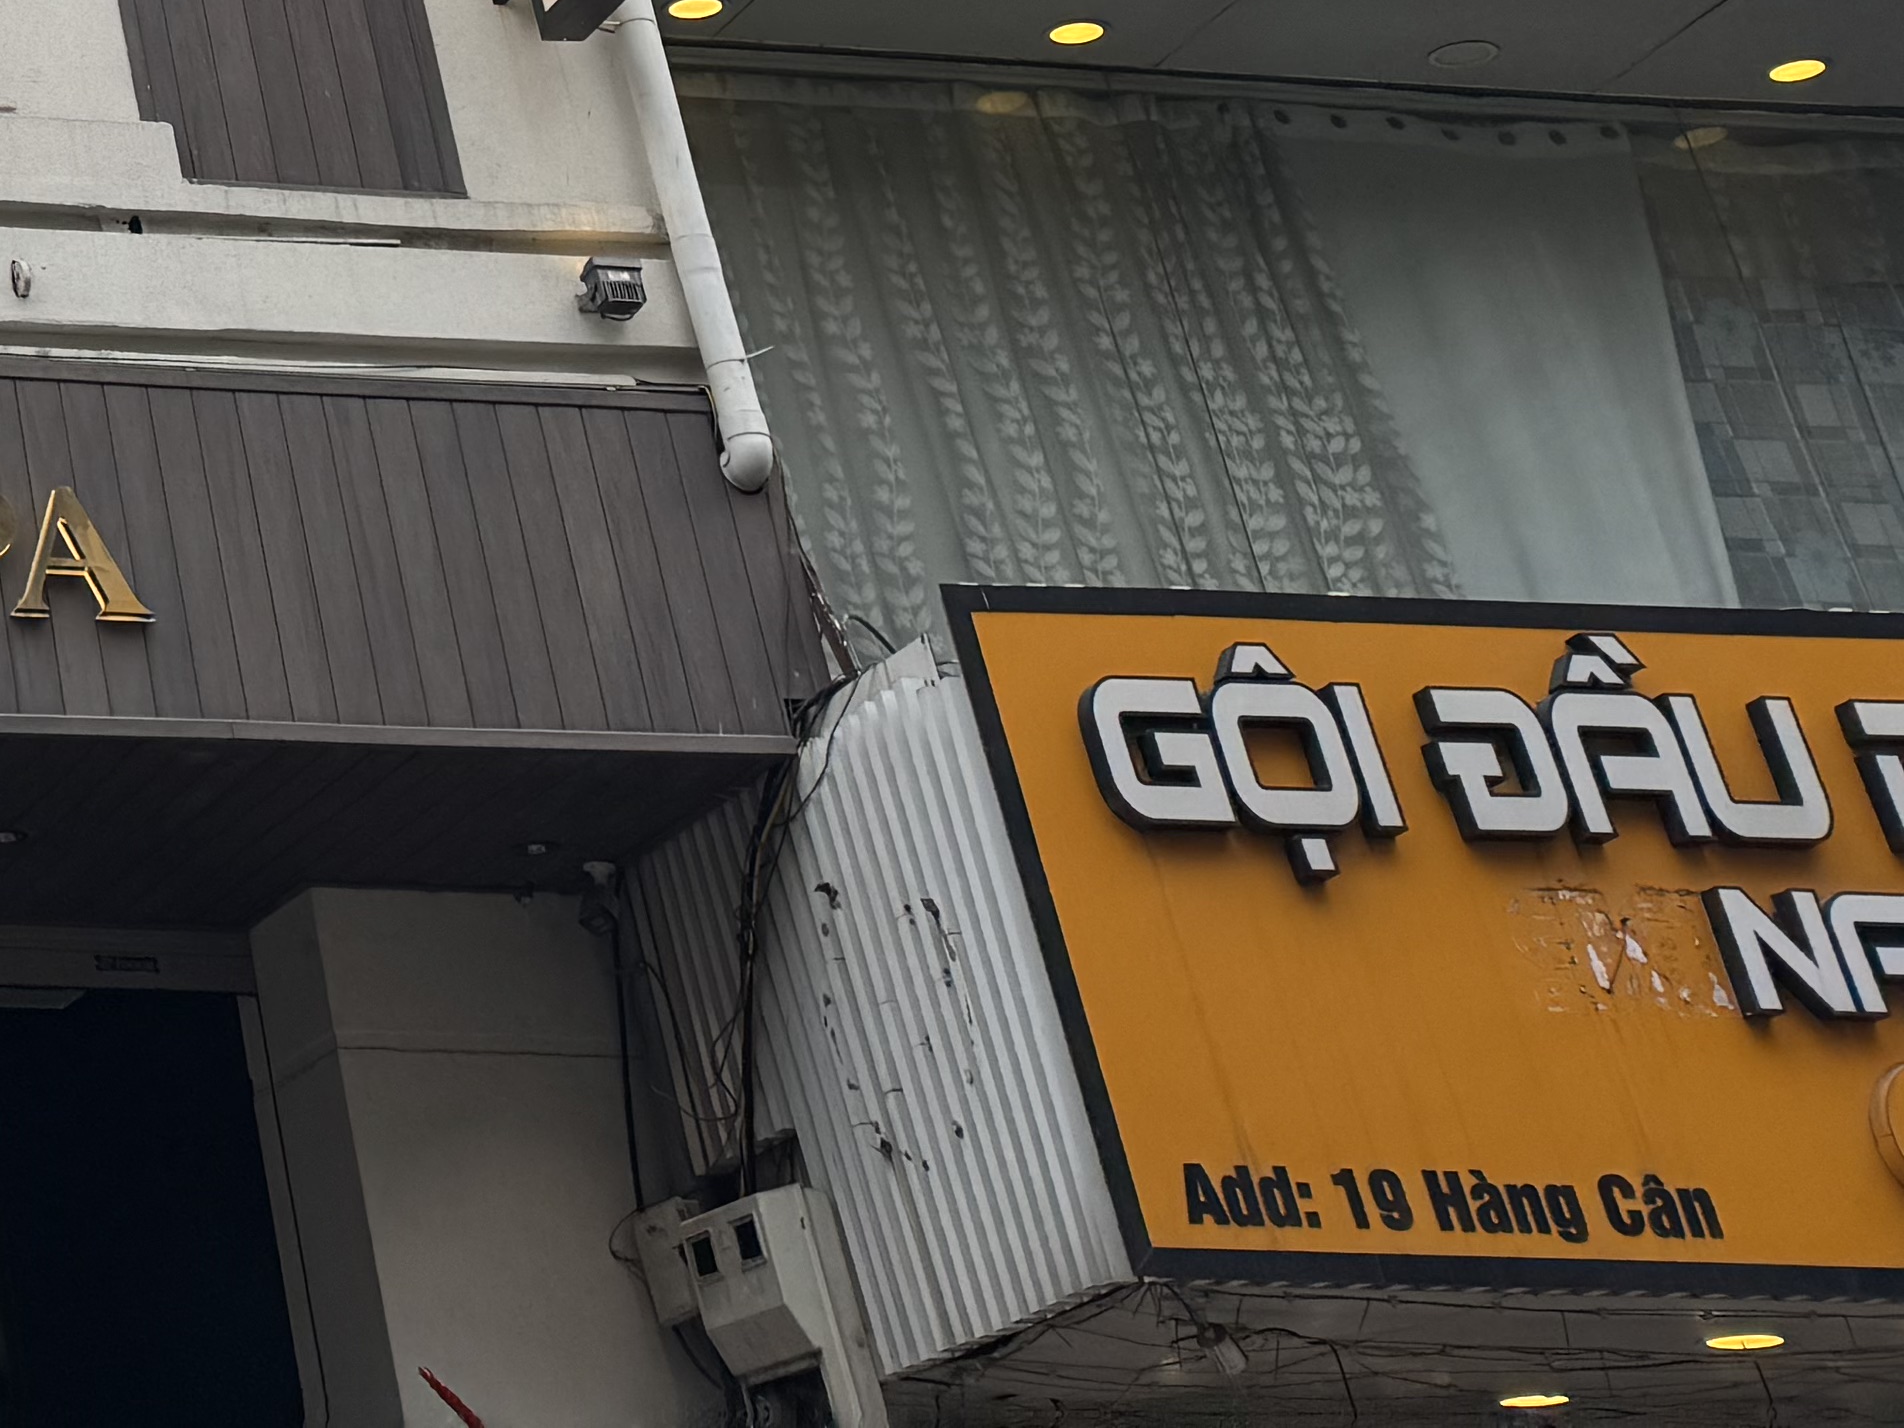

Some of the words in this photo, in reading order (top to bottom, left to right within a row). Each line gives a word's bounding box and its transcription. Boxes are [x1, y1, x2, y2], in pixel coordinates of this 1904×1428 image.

[1078, 641, 1407, 884] GỘI
[1413, 632, 1834, 843] ĐẦU
[1183, 1162, 1321, 1229] Add:
[1330, 1168, 1414, 1231] 19
[1422, 1169, 1588, 1243] Hàng
[1600, 1173, 1725, 1240] Cân
